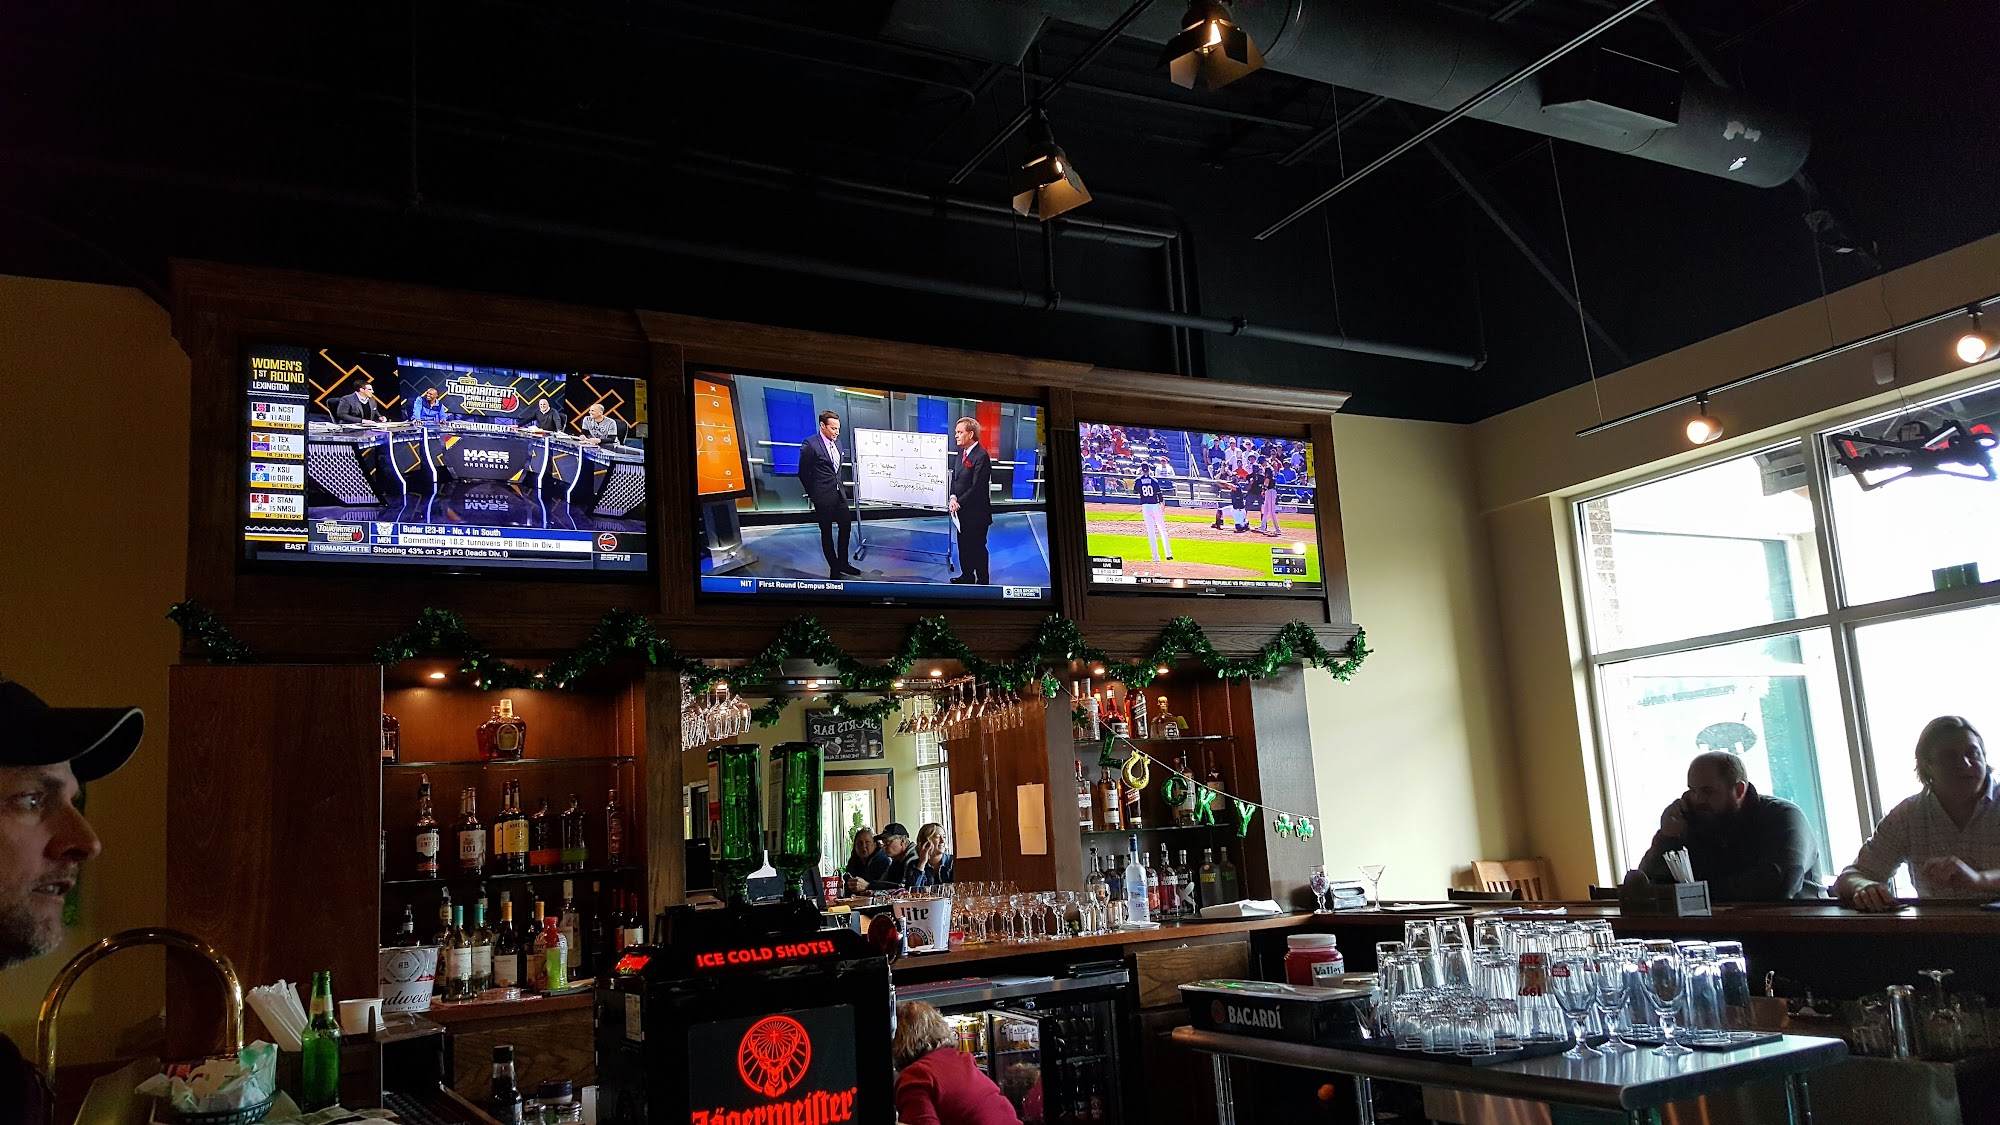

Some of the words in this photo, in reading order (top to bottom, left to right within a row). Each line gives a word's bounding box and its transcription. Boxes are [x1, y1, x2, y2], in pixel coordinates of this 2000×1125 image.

[252, 358, 302, 372] WOMEN'S
[253, 370, 267, 380] 1ST
[270, 372, 304, 384] ROUND
[252, 382, 290, 392] LEXINGTON
[449, 382, 514, 398] TOURNAMENT
[466, 394, 502, 403] CHALLENGE
[466, 401, 502, 409] MARATHON
[464, 449, 510, 458] MASS
[1142, 485, 1154, 496] 80
[402, 525, 423, 534] Butler
[403, 536, 446, 546] Committing
[373, 546, 406, 554] Shooting
[798, 582, 825, 591] (Campus
[826, 582, 844, 591] Sites)
[697, 953, 725, 968] ICE
[728, 947, 772, 965] COLD
[776, 940, 835, 958] SHOTS!
[1313, 966, 1341, 975] Valley
[384, 990, 430, 1005] udweise
